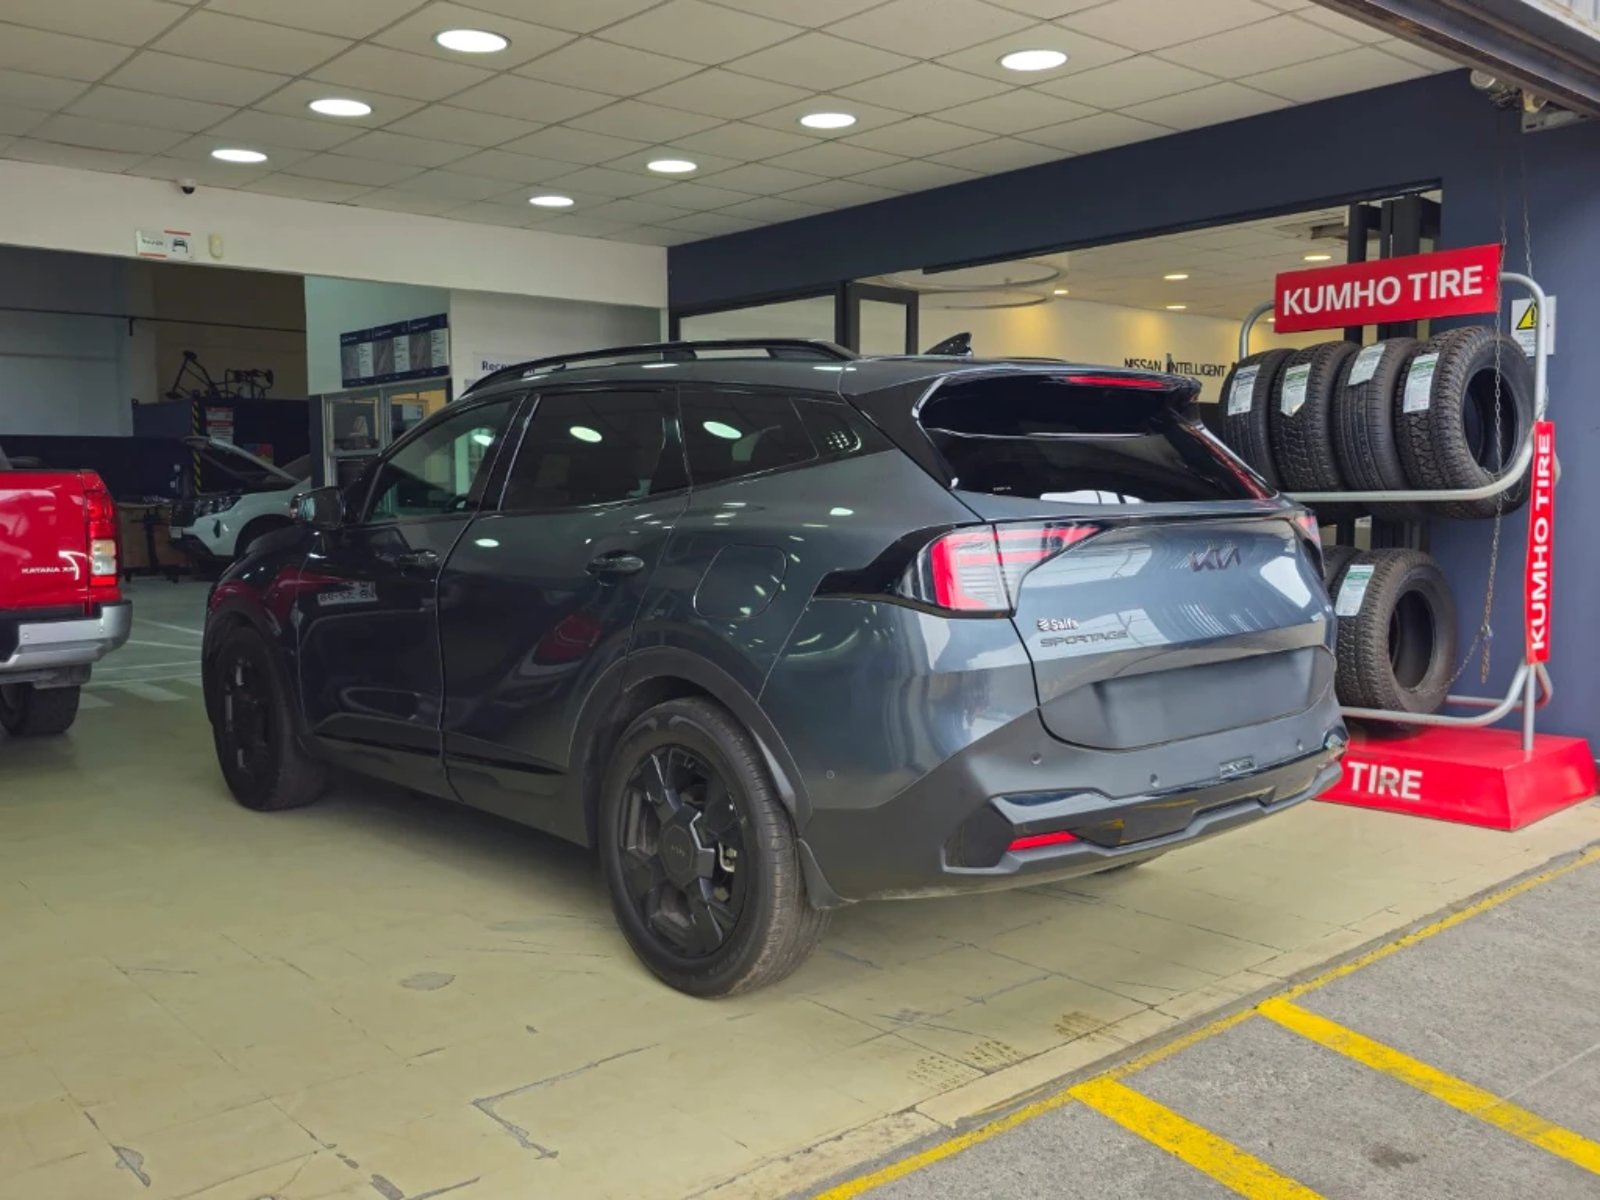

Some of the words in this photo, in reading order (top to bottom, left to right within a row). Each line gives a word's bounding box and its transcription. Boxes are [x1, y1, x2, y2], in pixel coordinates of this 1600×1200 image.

[1283, 276, 1400, 316] KUMHO
[1407, 265, 1483, 302] TIRE
[1124, 358, 1162, 372] NISSAN
[1166, 361, 1227, 377] INTELLIGENT
[1535, 433, 1551, 511] TIRE
[1190, 547, 1242, 572] KIA
[1531, 516, 1549, 650] KUMHO
[1040, 631, 1128, 647] SPORTAGE
[1347, 761, 1423, 801] TIRE
